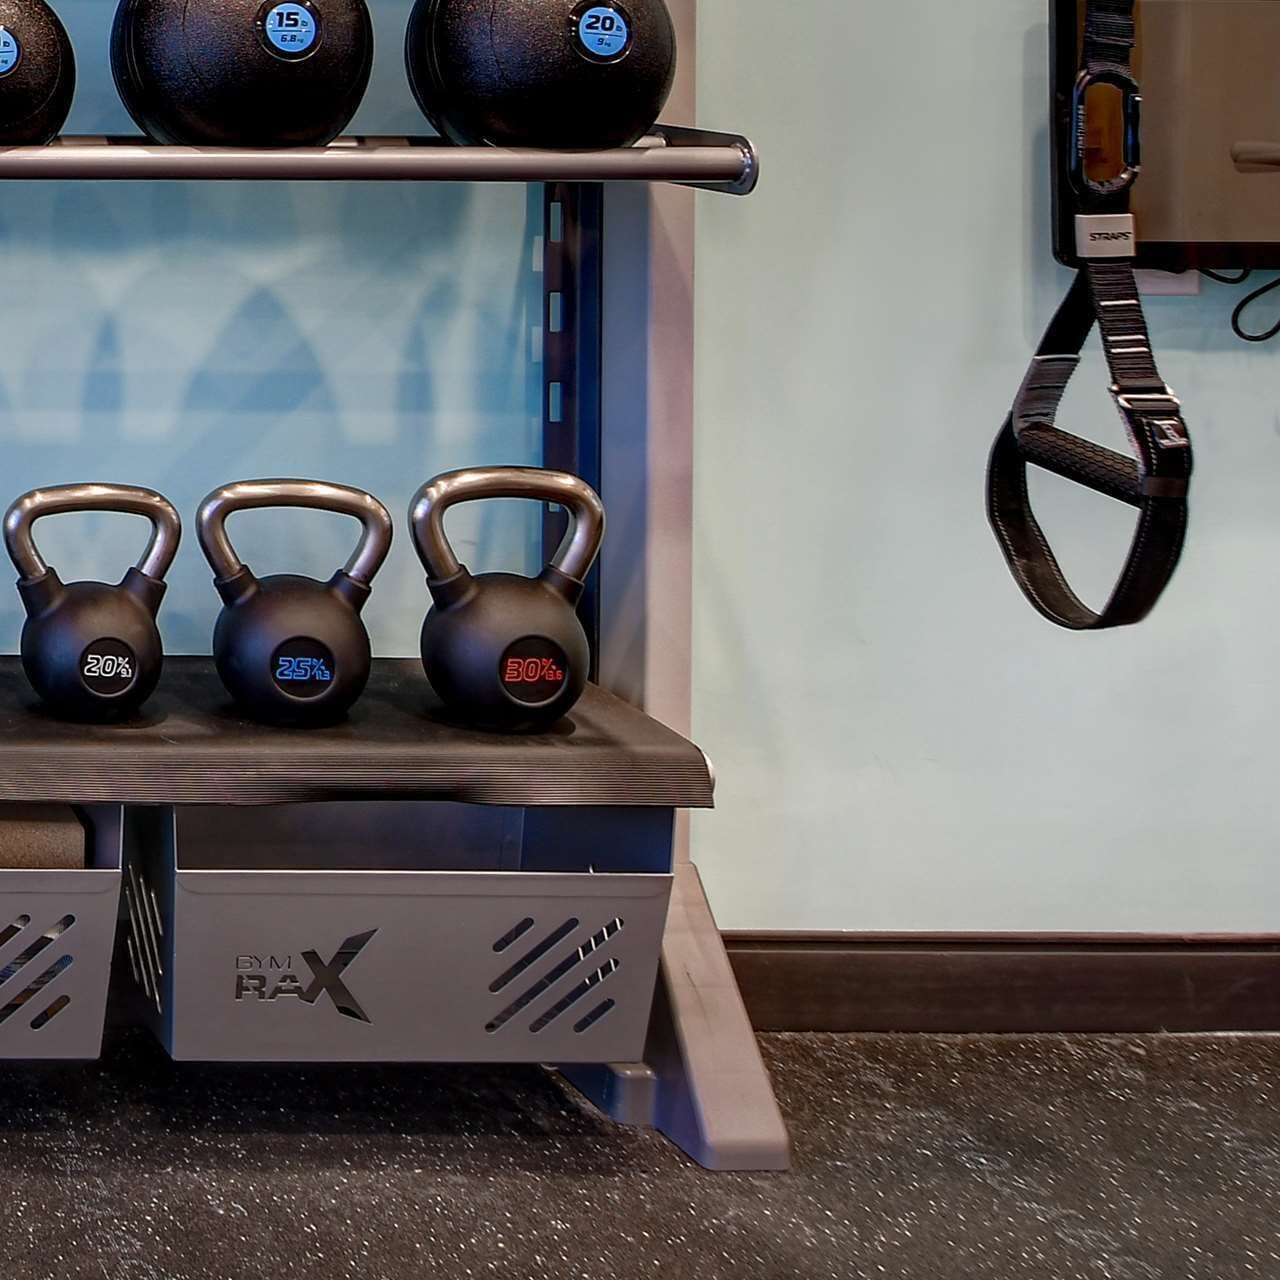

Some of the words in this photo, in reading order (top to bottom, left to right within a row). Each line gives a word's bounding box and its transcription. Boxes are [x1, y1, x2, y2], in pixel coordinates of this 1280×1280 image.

[276, 11, 300, 28] 15
[585, 14, 615, 32] 20
[83, 654, 117, 677] 20
[276, 656, 311, 680] 25
[505, 658, 541, 682] 30
[236, 955, 291, 971] GYM
[235, 927, 382, 1025] RAX
